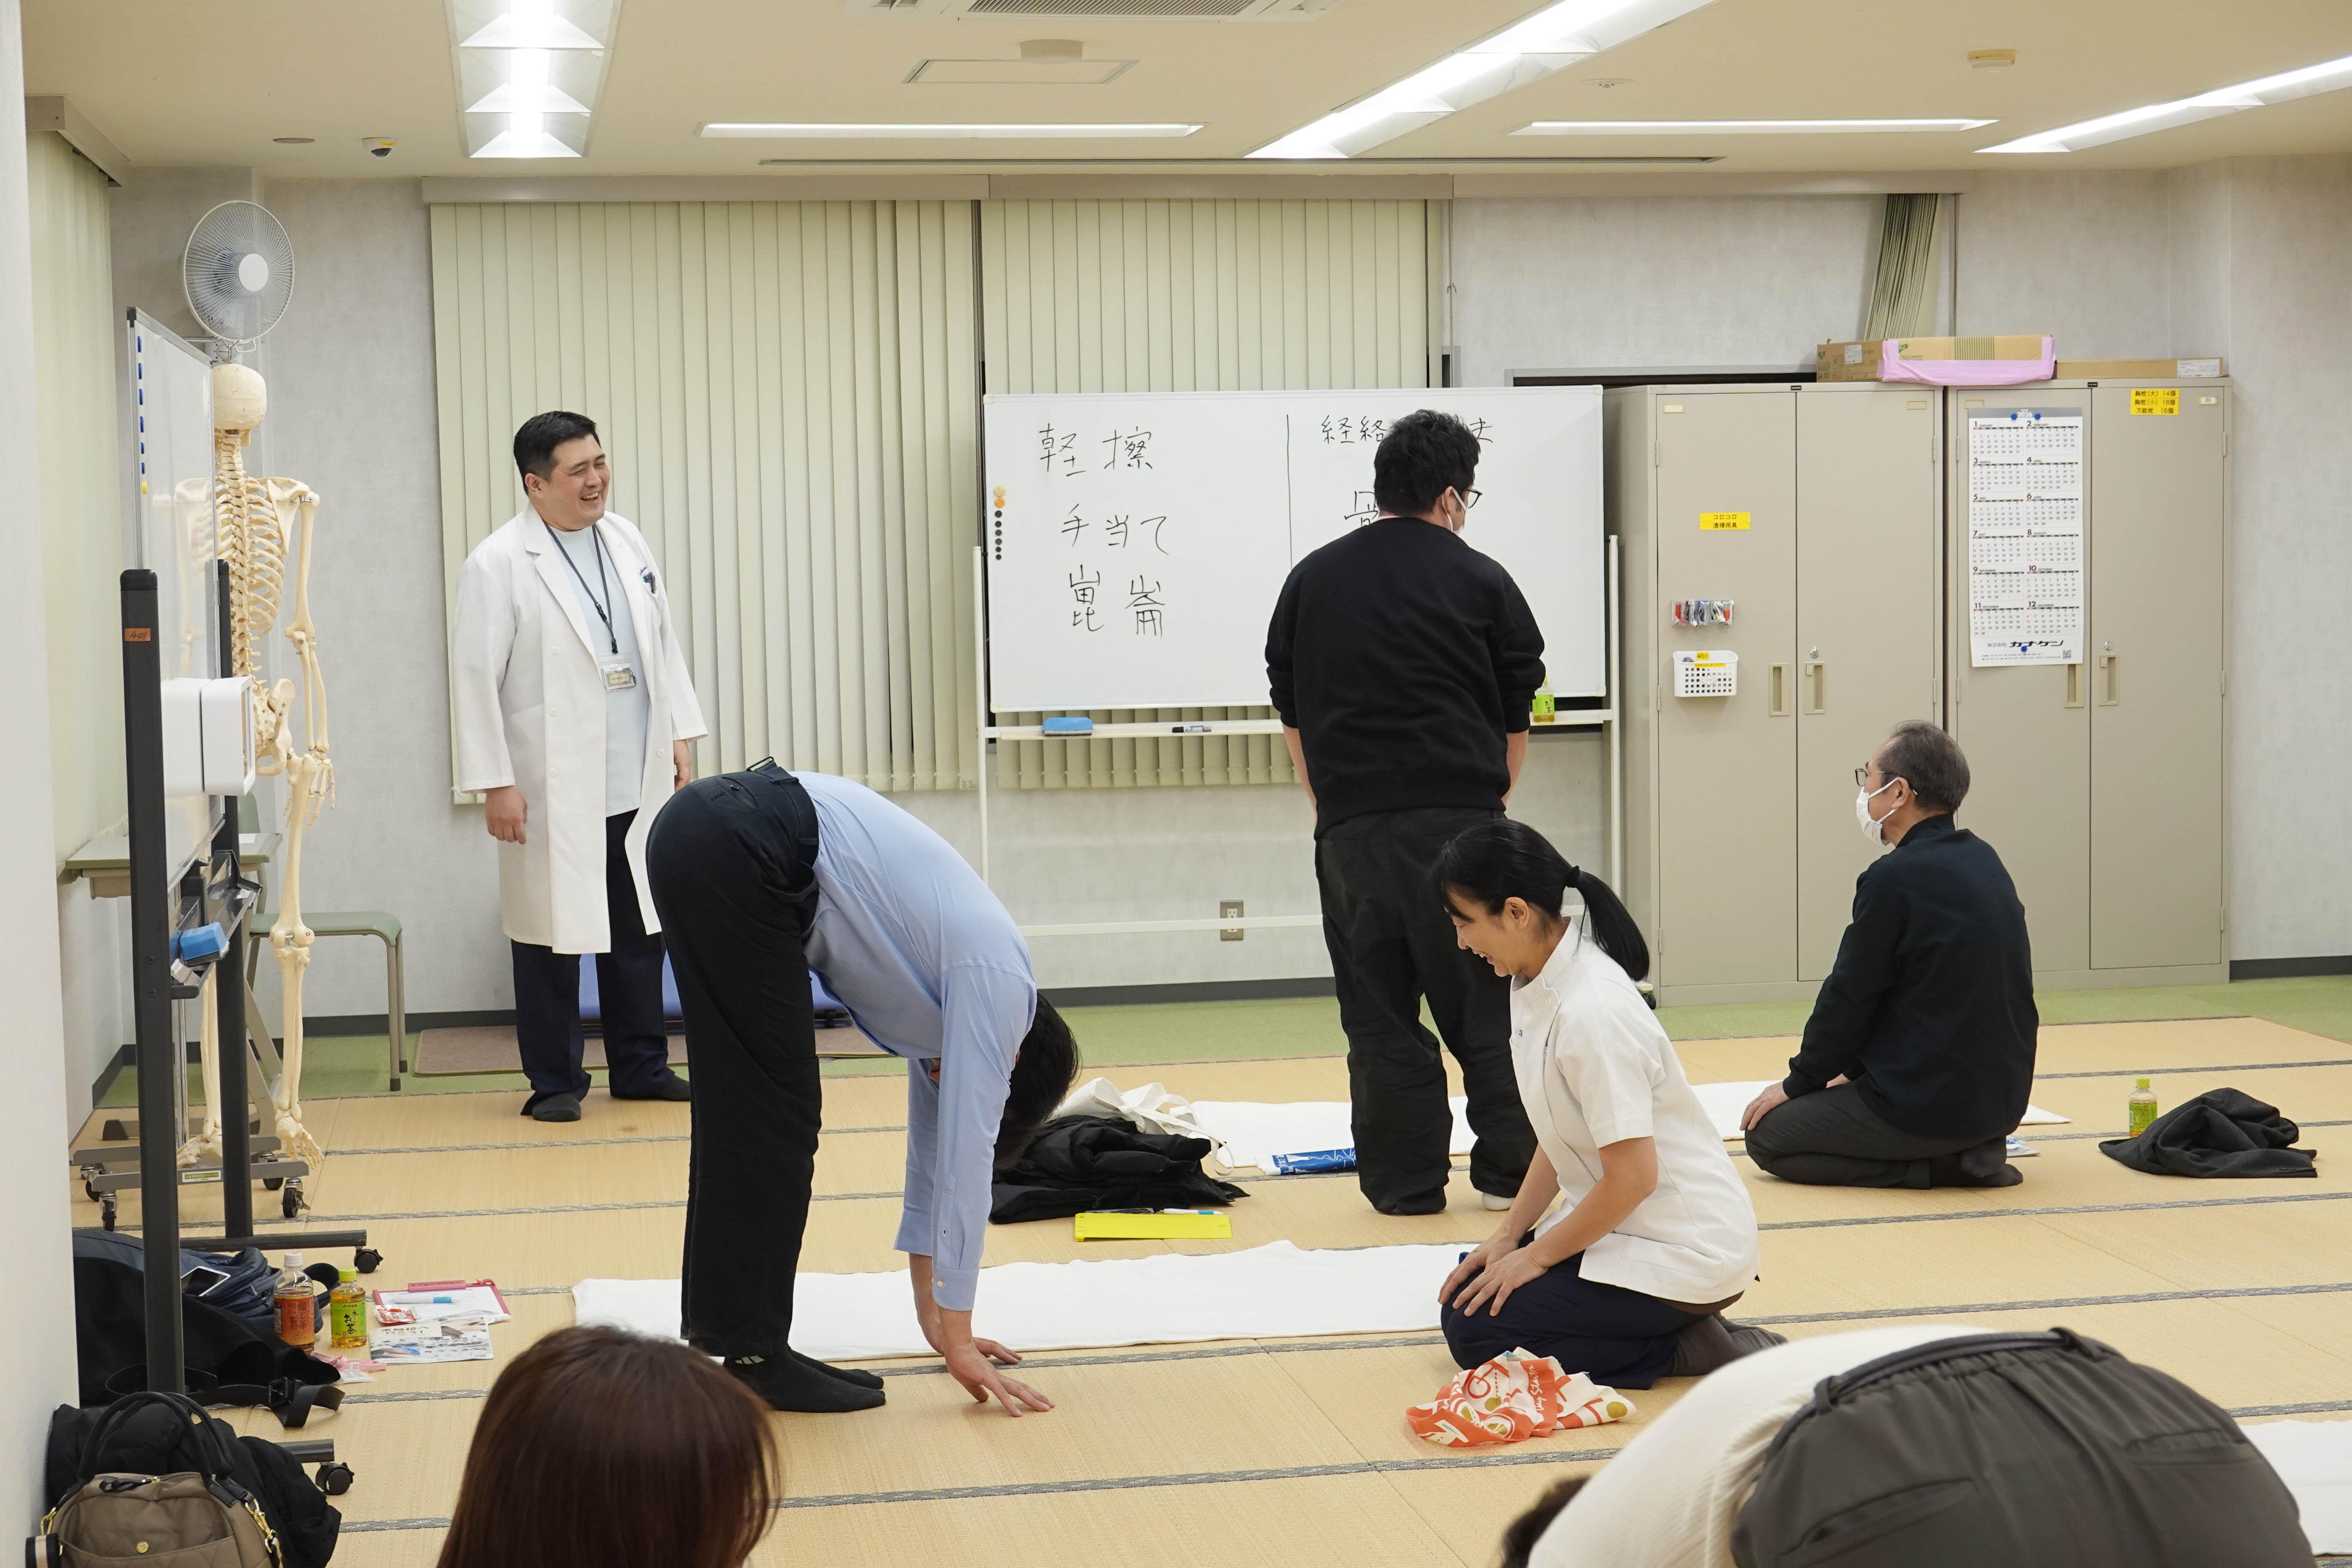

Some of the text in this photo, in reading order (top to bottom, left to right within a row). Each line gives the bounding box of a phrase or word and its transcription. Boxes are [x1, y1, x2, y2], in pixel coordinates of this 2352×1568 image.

[1039, 423, 1153, 477] 軽擦
[1061, 503, 1169, 555] 手当て
[131, 631, 147, 640] 401
[344, 1314, 357, 1335] お茶
